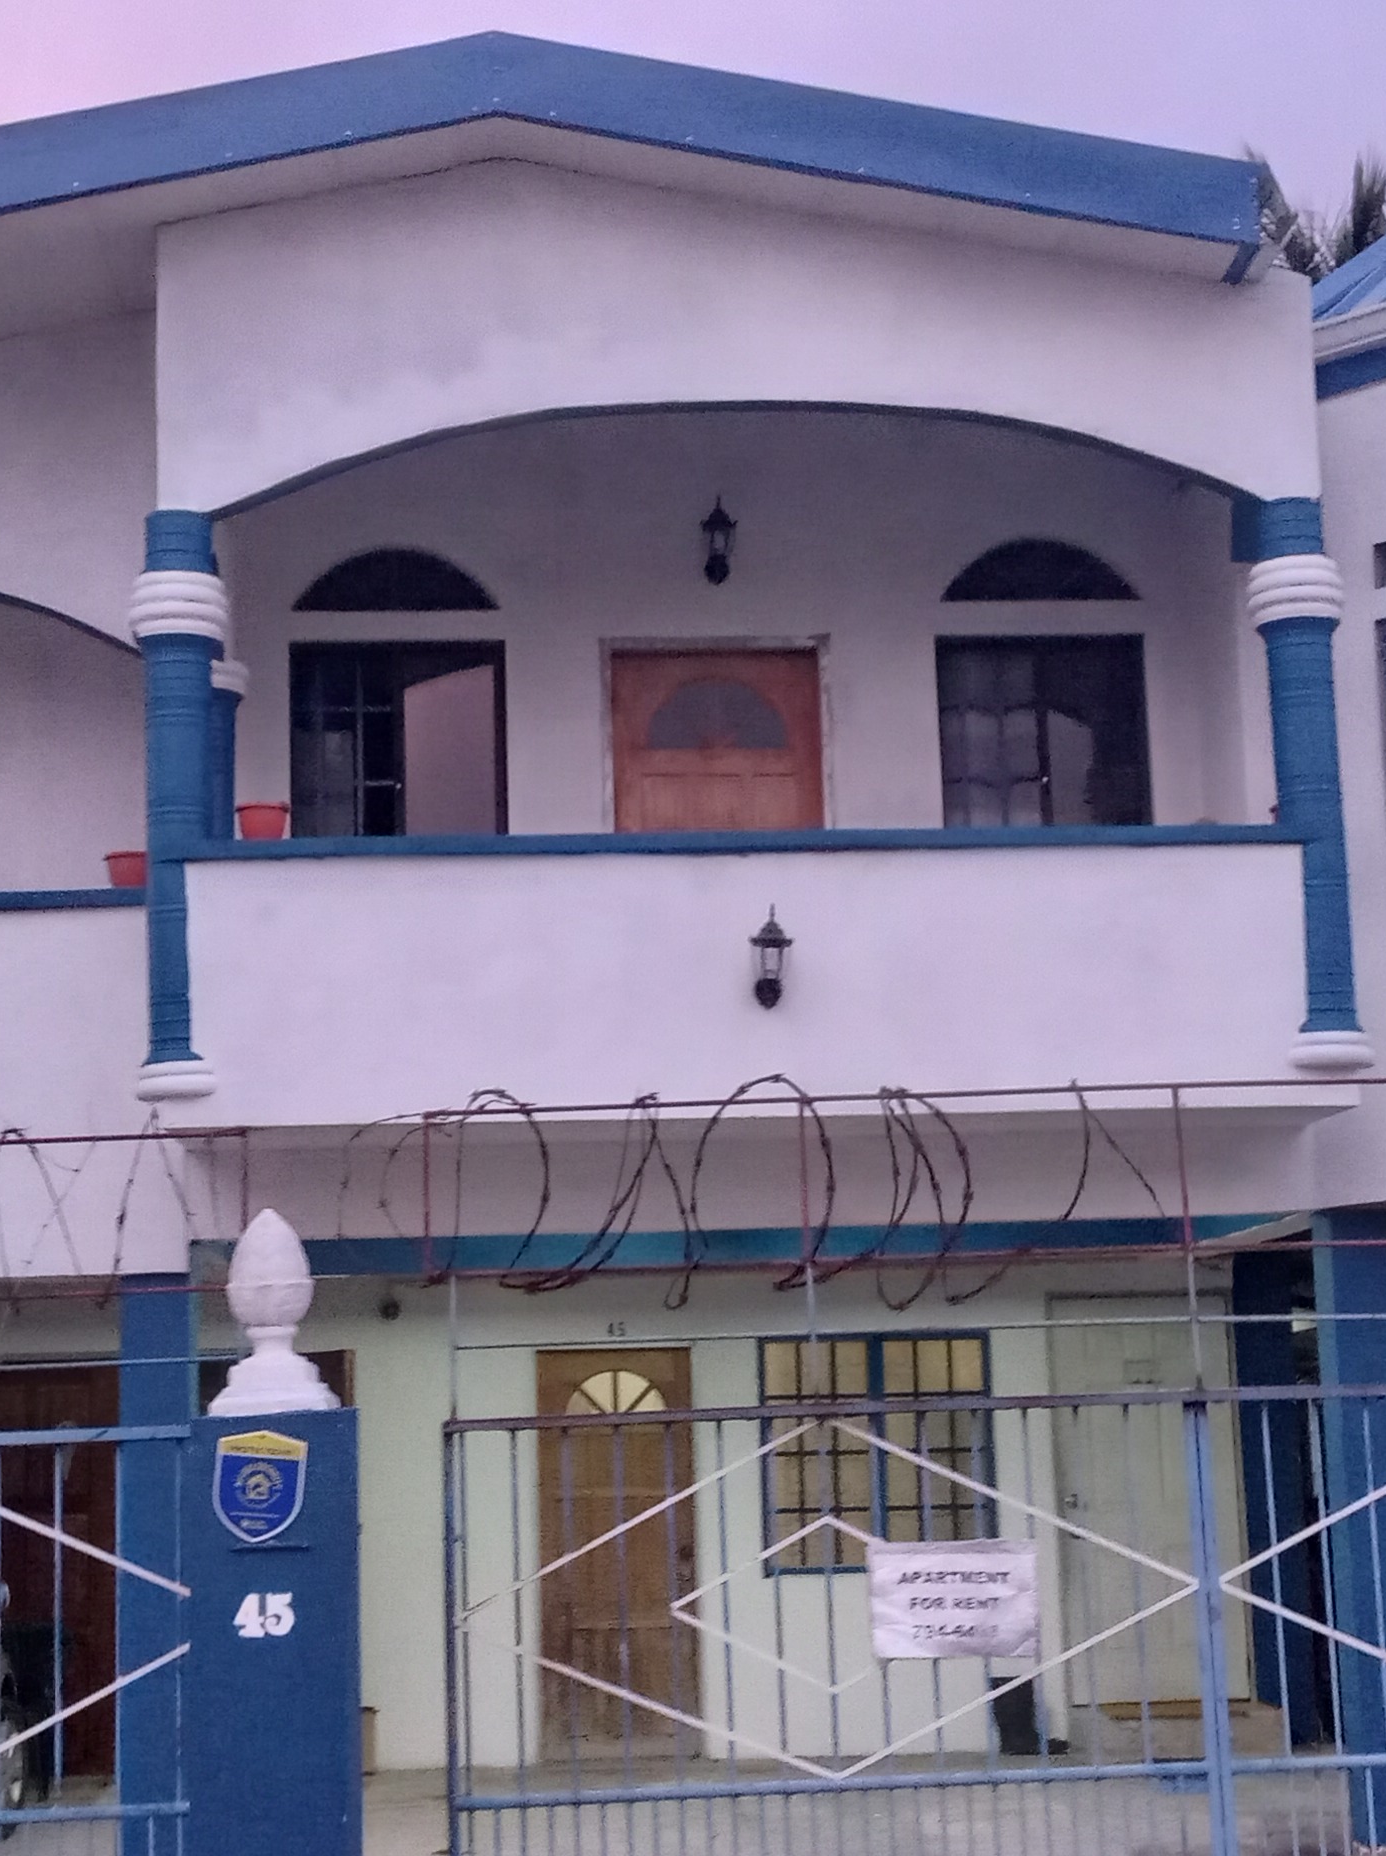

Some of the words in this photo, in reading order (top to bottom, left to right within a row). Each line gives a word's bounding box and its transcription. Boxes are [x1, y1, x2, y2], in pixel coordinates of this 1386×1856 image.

[897, 1571, 1011, 1585] APARTMENT
[909, 1597, 947, 1611] FOR
[952, 1597, 1001, 1611] RENT
[232, 1592, 295, 1638] 45
